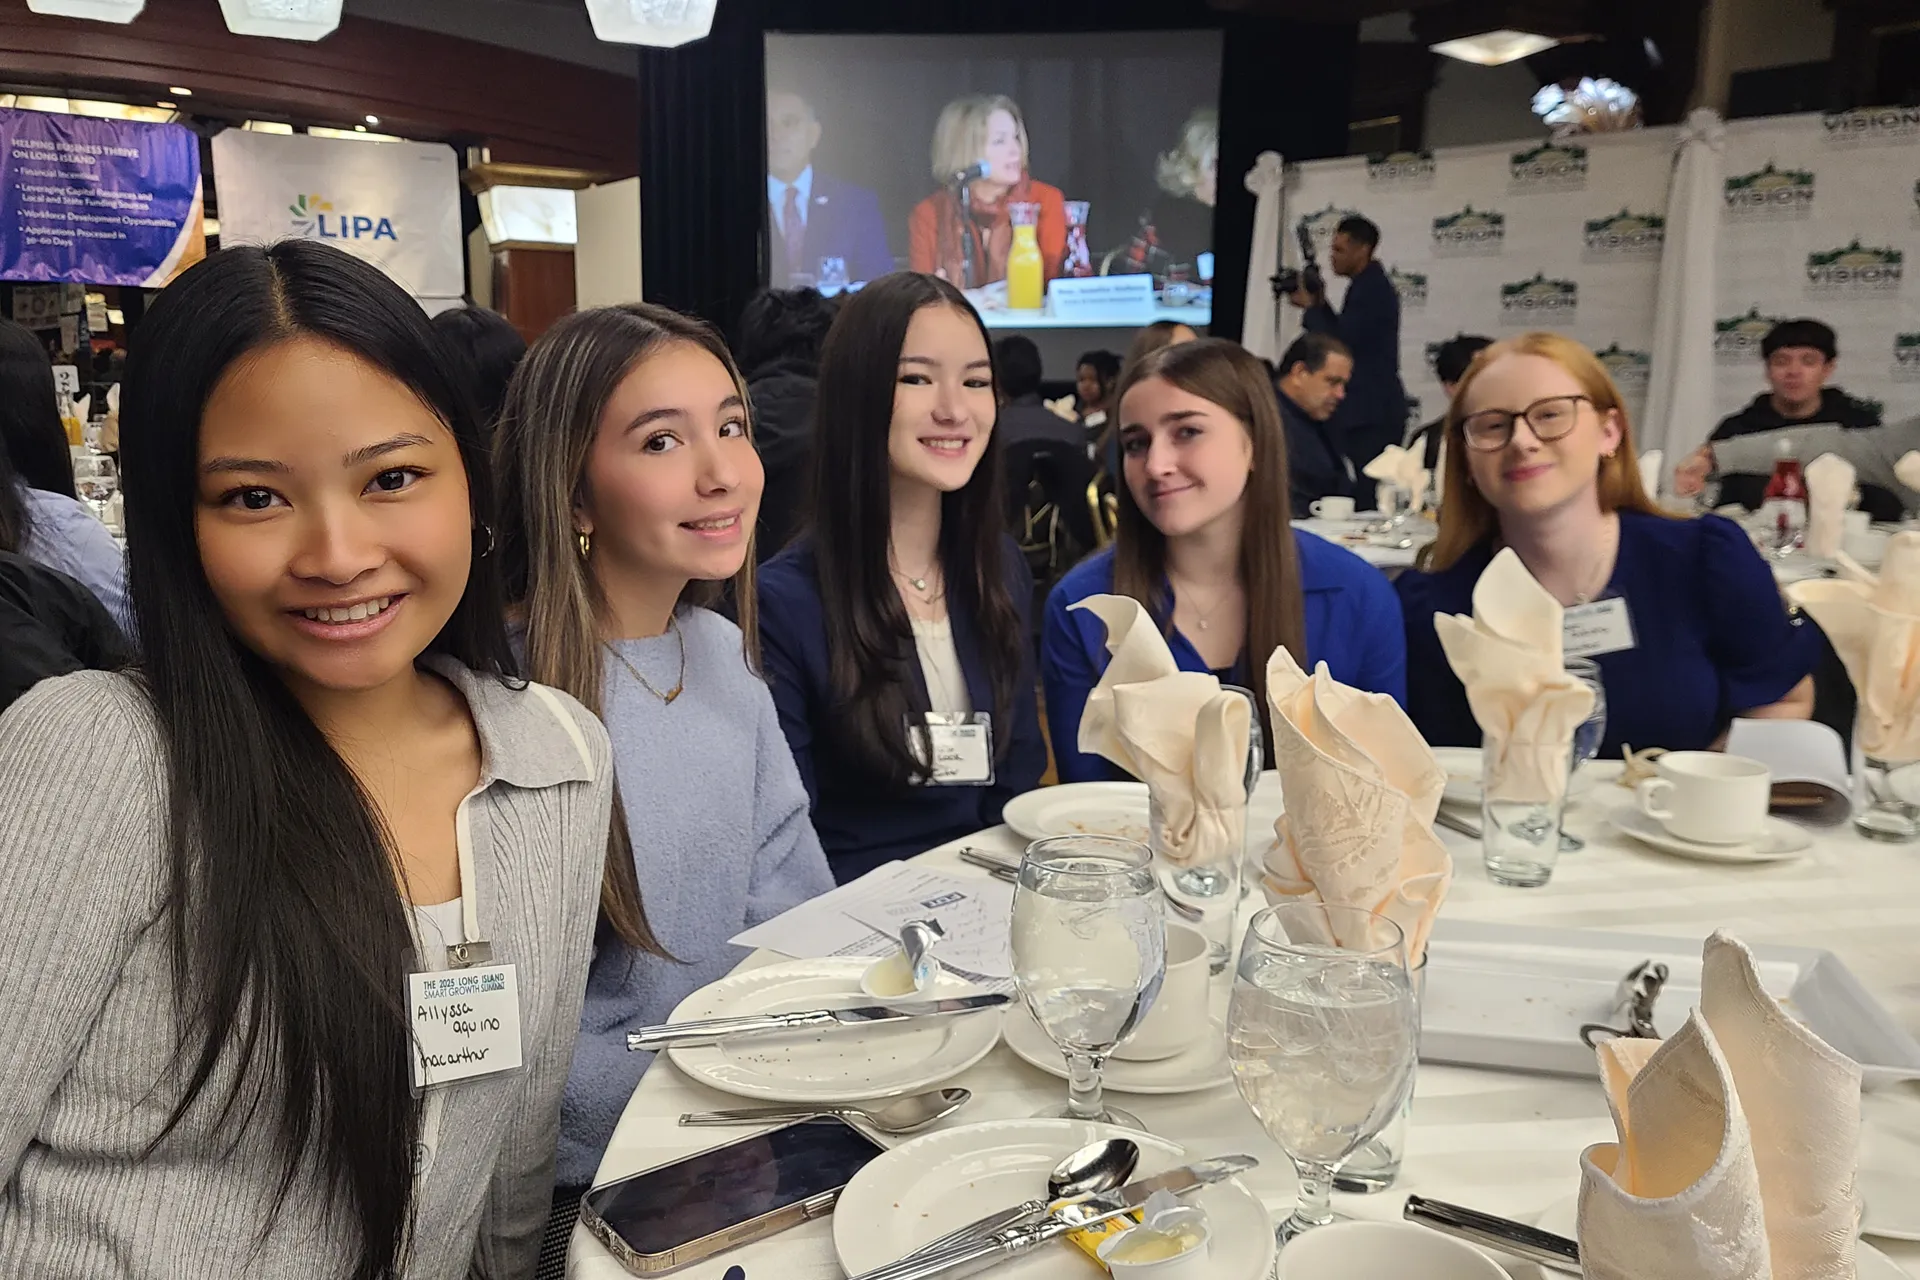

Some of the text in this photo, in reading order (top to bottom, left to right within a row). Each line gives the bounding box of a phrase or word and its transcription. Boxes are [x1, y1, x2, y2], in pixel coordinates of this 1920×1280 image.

[12, 138, 56, 151] HELPING
[103, 146, 139, 159] THRIVE
[12, 149, 96, 165] ON LONG ISLAND
[21, 183, 65, 196] Leveraging
[22, 193, 44, 203] Local
[46, 195, 61, 204] and
[85, 198, 118, 209] Funding
[23, 209, 176, 228] Workforce Development Opportunities
[25, 226, 75, 237] Applications
[118, 231, 126, 240] in
[318, 215, 397, 240] LIPA
[53, 237, 73, 247] Days
[424, 973, 505, 990] THE 2025 LONG ISLAND
[424, 988, 447, 999] SMART
[448, 984, 479, 997] GROWTH
[418, 1003, 473, 1024] Allyssa
